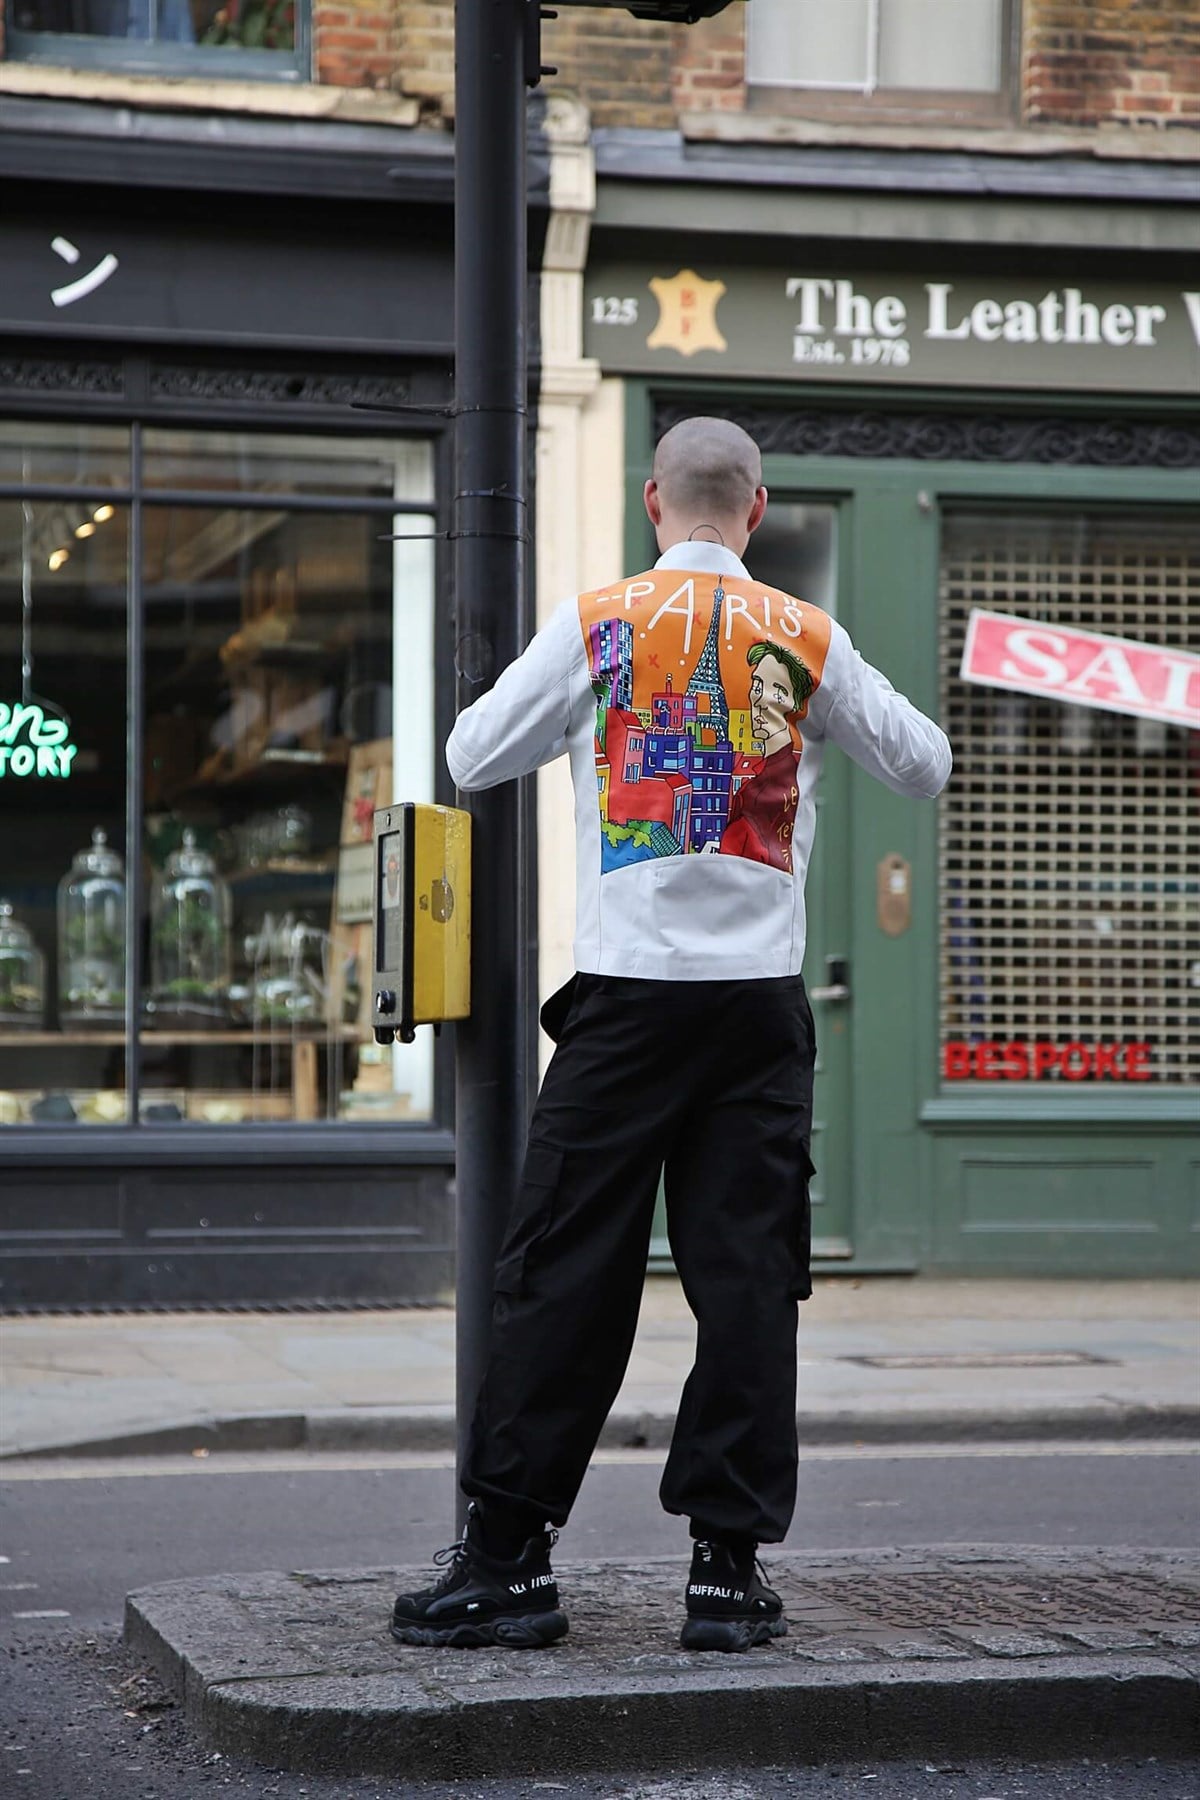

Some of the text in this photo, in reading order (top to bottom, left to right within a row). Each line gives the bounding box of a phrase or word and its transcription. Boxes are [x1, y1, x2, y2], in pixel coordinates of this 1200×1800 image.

[591, 296, 638, 325] 125
[786, 278, 907, 338] The
[924, 283, 1167, 346] Leather
[793, 335, 911, 367] Est. 1978
[943, 1041, 1153, 1080] BESPOKE
